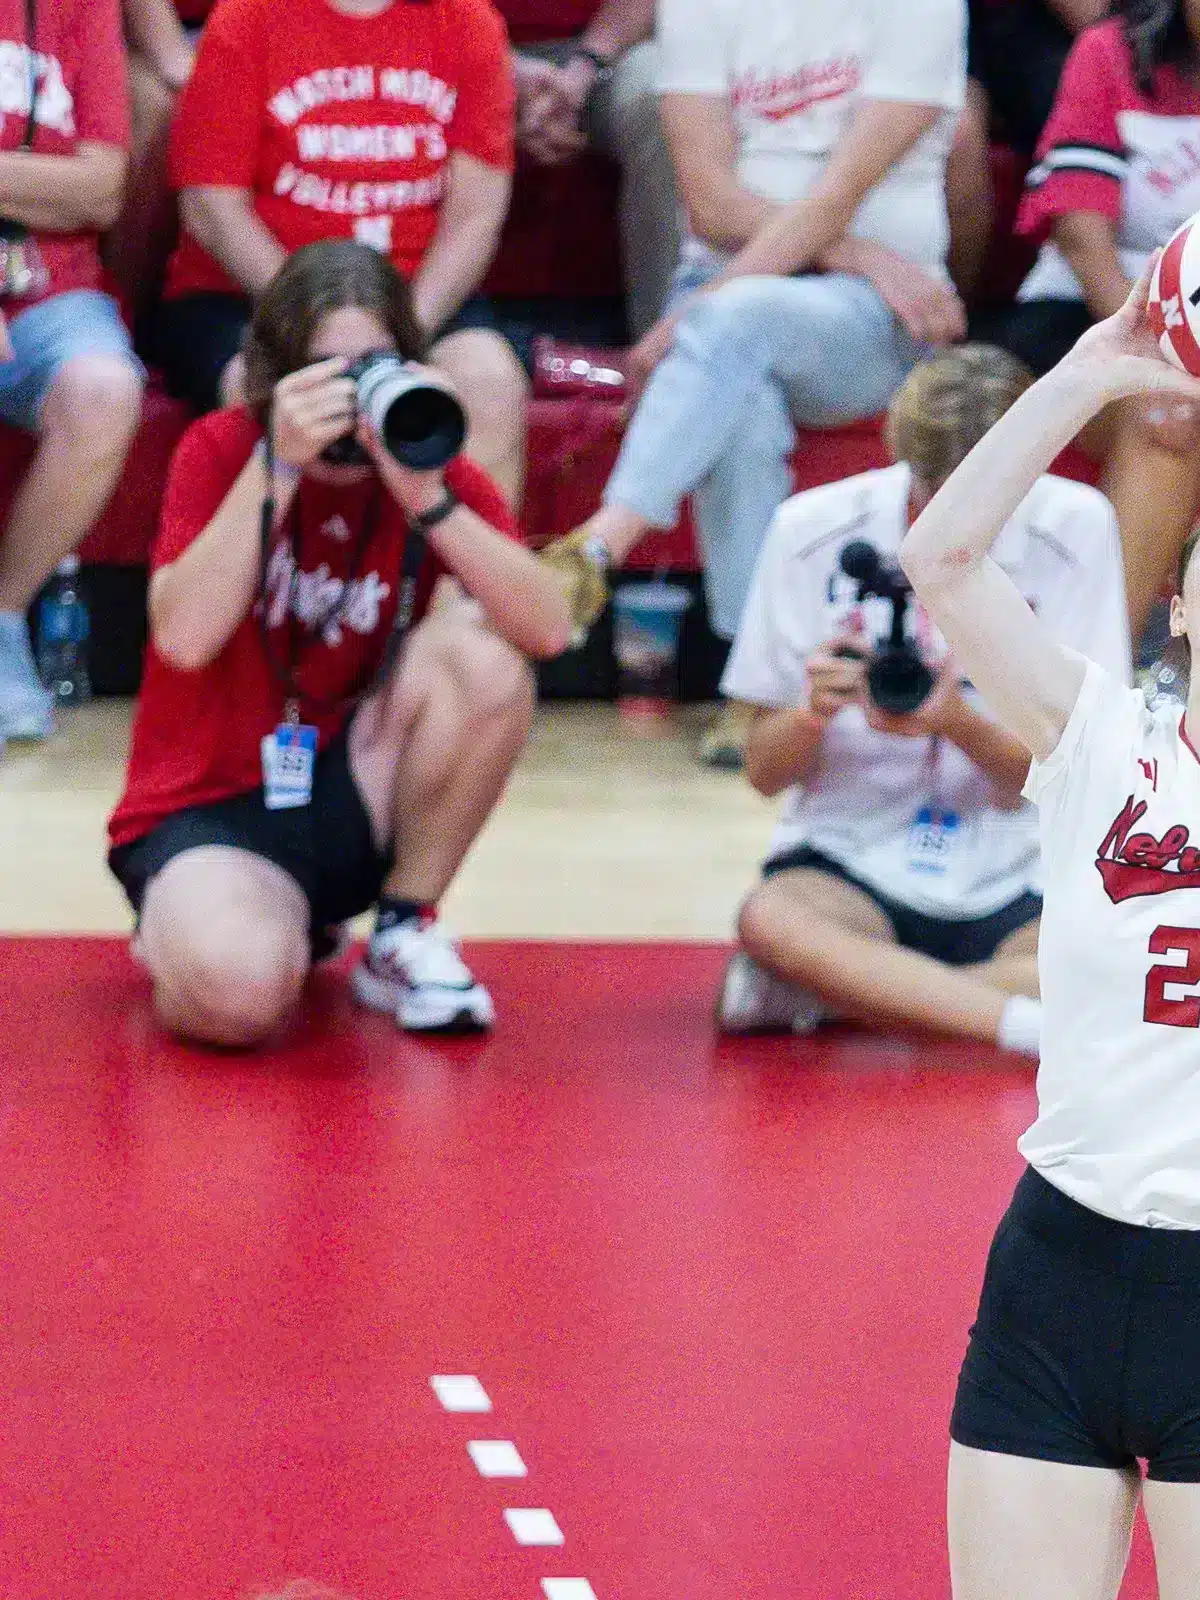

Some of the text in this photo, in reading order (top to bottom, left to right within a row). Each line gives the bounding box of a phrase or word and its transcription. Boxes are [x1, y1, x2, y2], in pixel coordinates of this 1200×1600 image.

[267, 64, 457, 126] WATCH MORE
[297, 124, 448, 162] WOMEN'S
